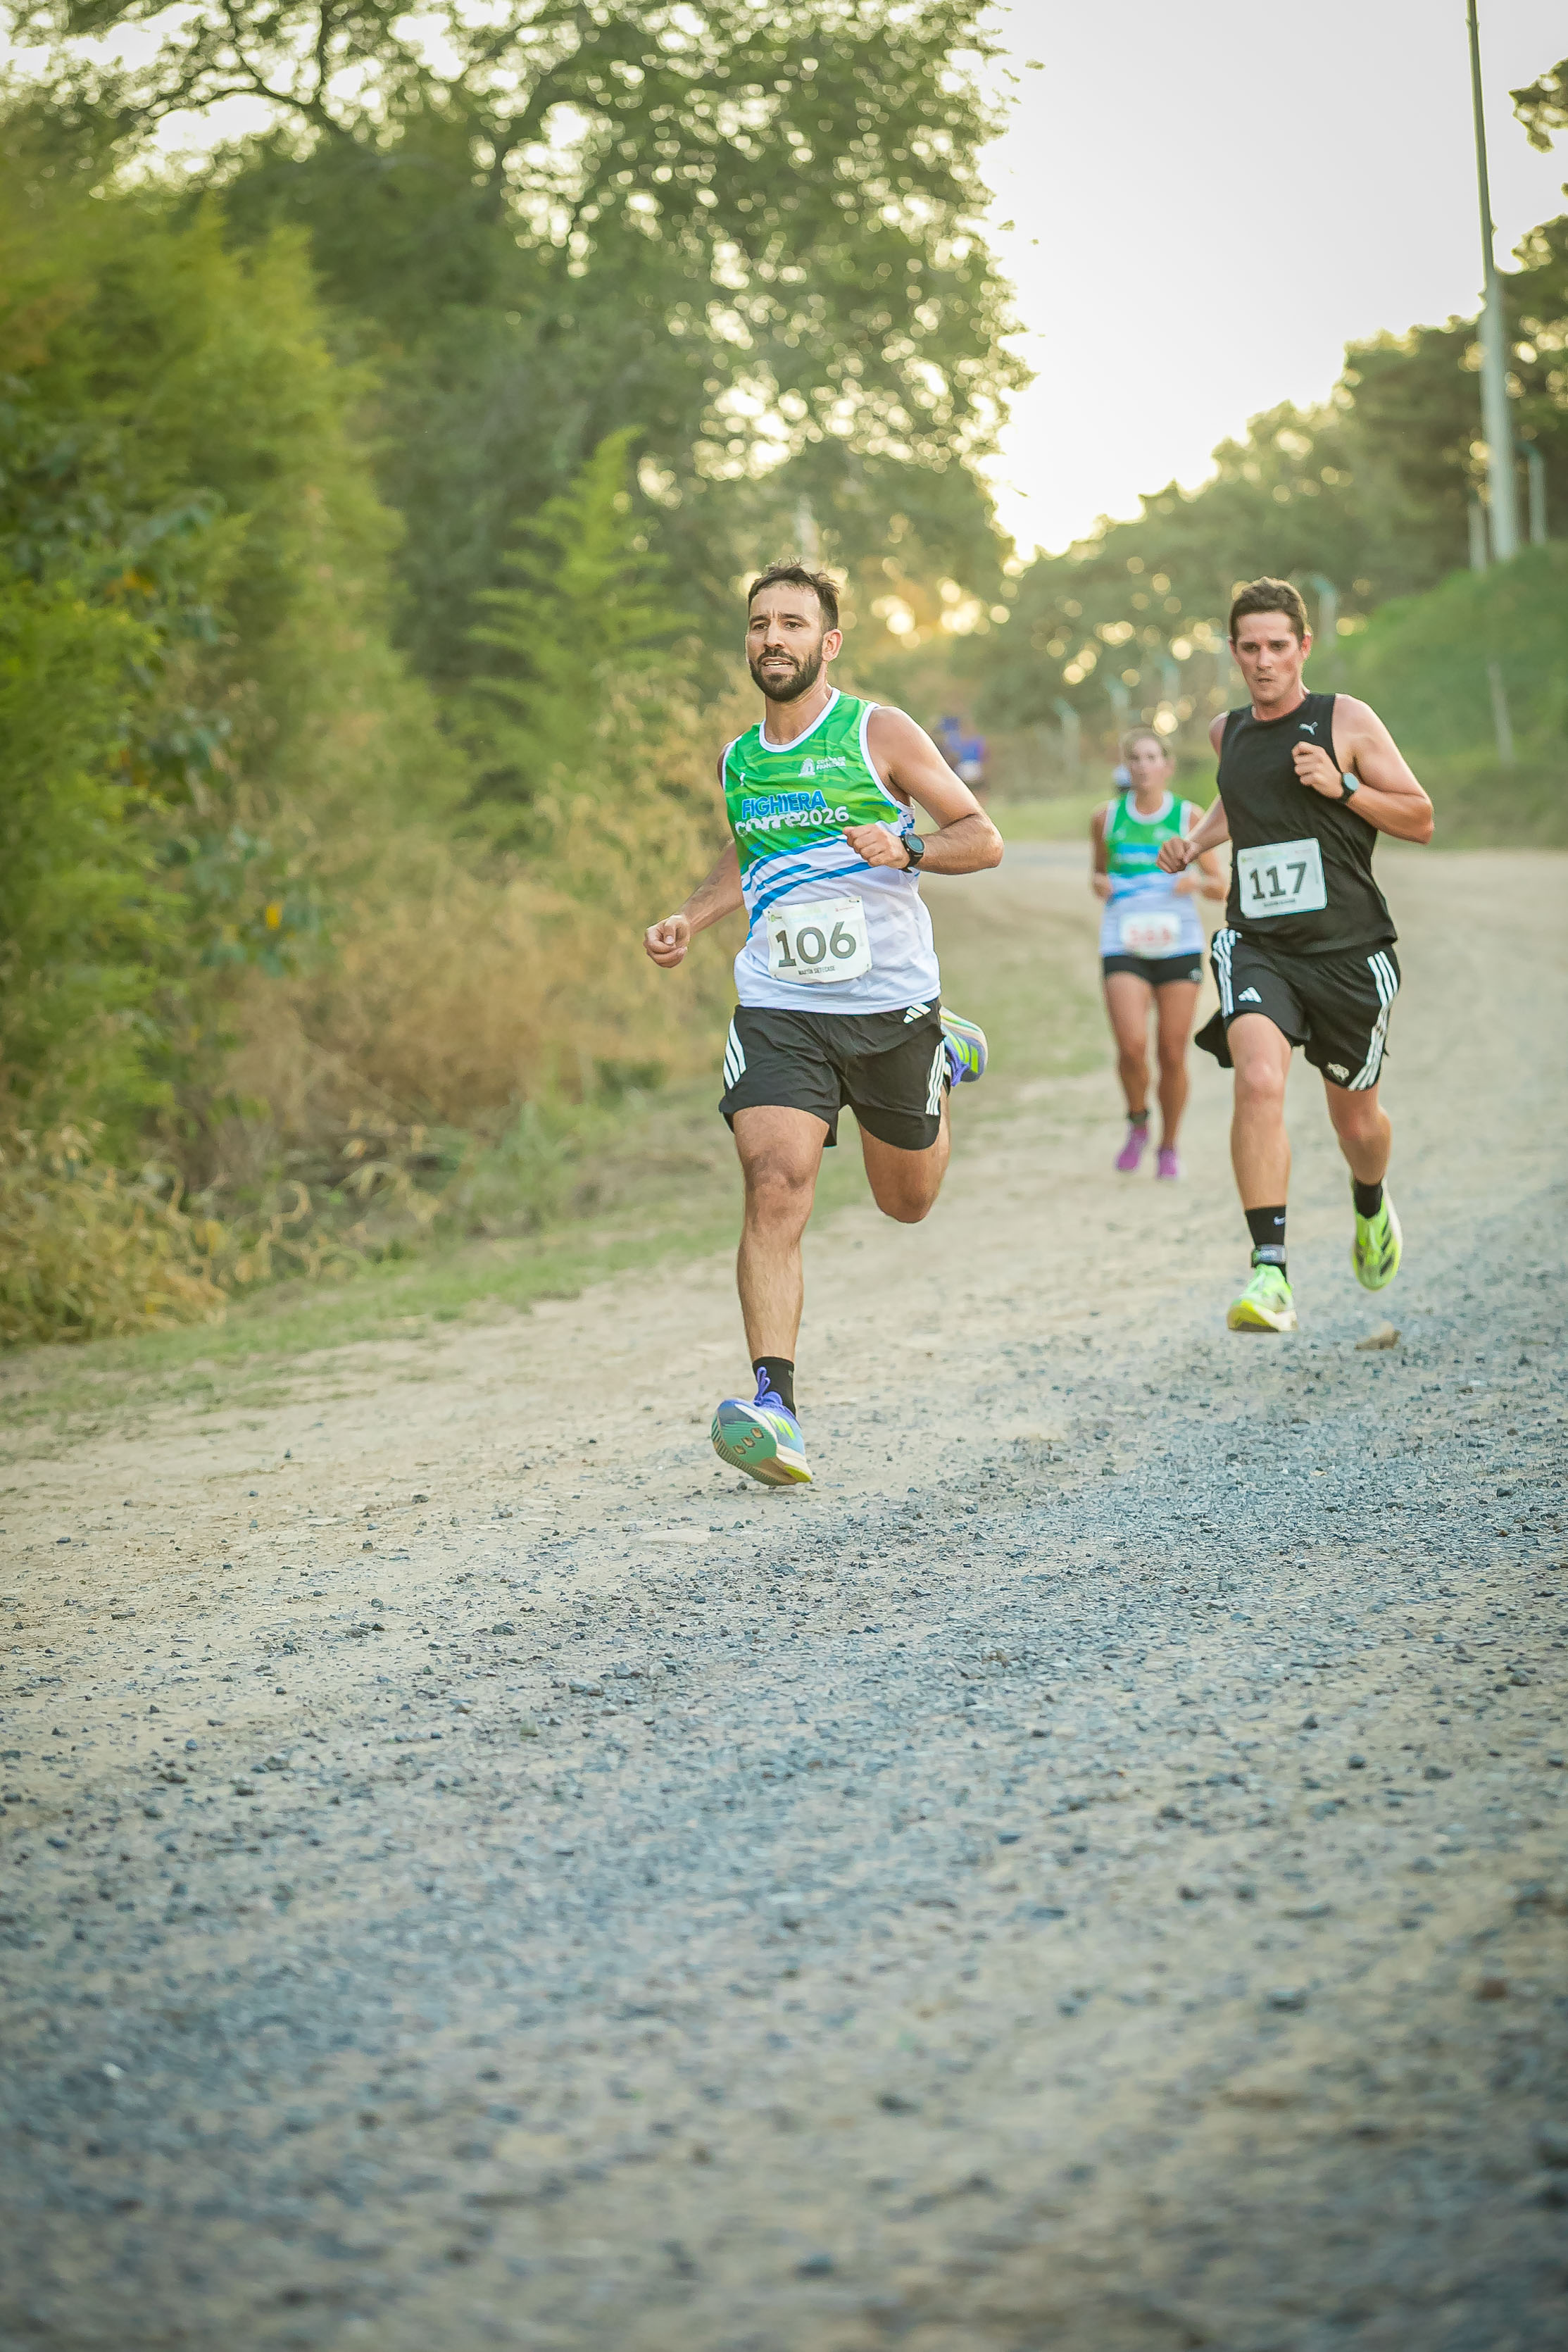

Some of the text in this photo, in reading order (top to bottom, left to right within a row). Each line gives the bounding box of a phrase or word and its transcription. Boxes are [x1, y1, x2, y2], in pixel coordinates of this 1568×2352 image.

[742, 789, 827, 819] FIGHIERA
[1250, 861, 1307, 899] 117
[776, 921, 856, 967] 106
